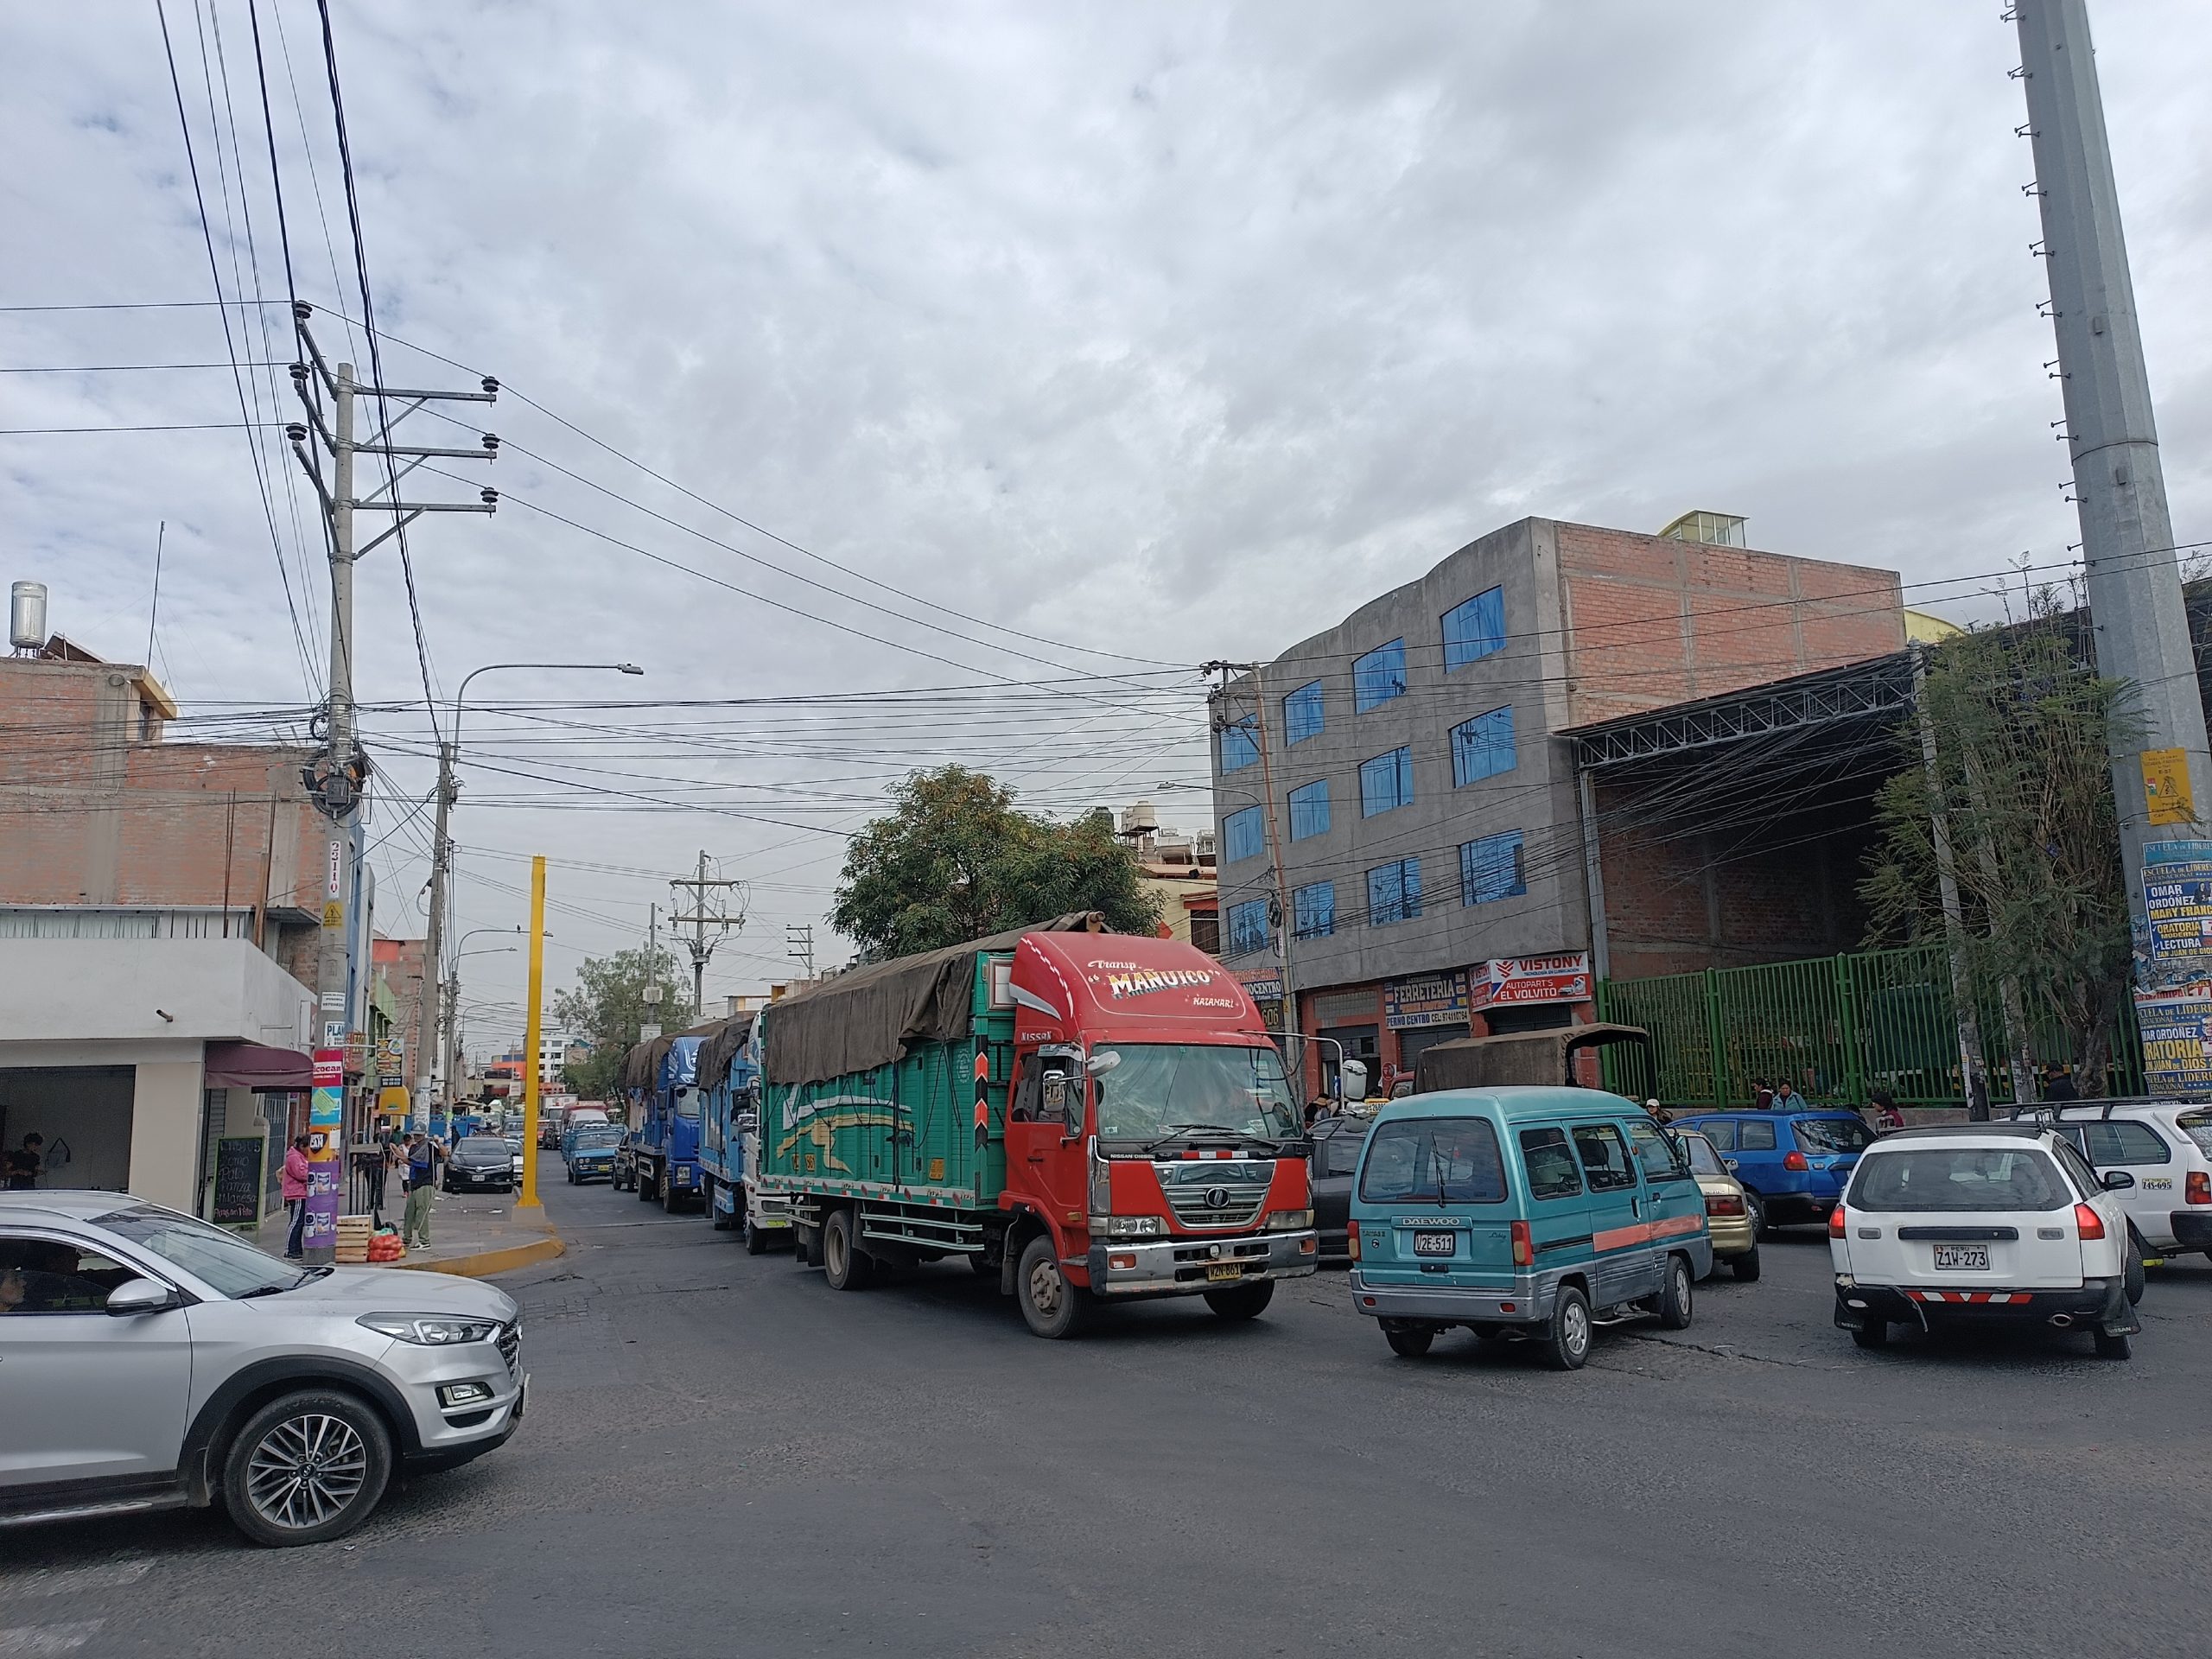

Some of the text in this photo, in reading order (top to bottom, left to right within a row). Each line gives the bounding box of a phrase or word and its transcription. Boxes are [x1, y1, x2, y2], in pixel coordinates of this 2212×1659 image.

[2145, 843, 2178, 853] ESCUELA
[2144, 866, 2177, 877] ESCUELA
[2151, 884, 2183, 897] OMAR
[2148, 894, 2196, 909] ORDÓÑEZ
[2150, 906, 2178, 919] MARY
[2157, 921, 2202, 933] ORATORIA
[2161, 931, 2200, 939] MODERNA
[2159, 938, 2202, 950] LECTURA
[2170, 949, 2187, 957] JUAN
[1519, 955, 1582, 971] VISTONY
[1393, 979, 1456, 1003] FERRETERIA
[1514, 987, 1557, 999] VOLVITO
[1386, 1014, 1406, 1027] PERNO
[1406, 1013, 1430, 1026] CENTRO
[1021, 1031, 1052, 1041] NISSAN
[2157, 1026, 2199, 1040] ORDÓÑEZ
[2154, 1059, 2172, 1071] JUAN
[2182, 1058, 2207, 1070] DIOS
[1402, 1217, 1460, 1226] DAEWOO
[1416, 1236, 1452, 1251] V2E-511
[1937, 1251, 1986, 1266] Z1W-273
